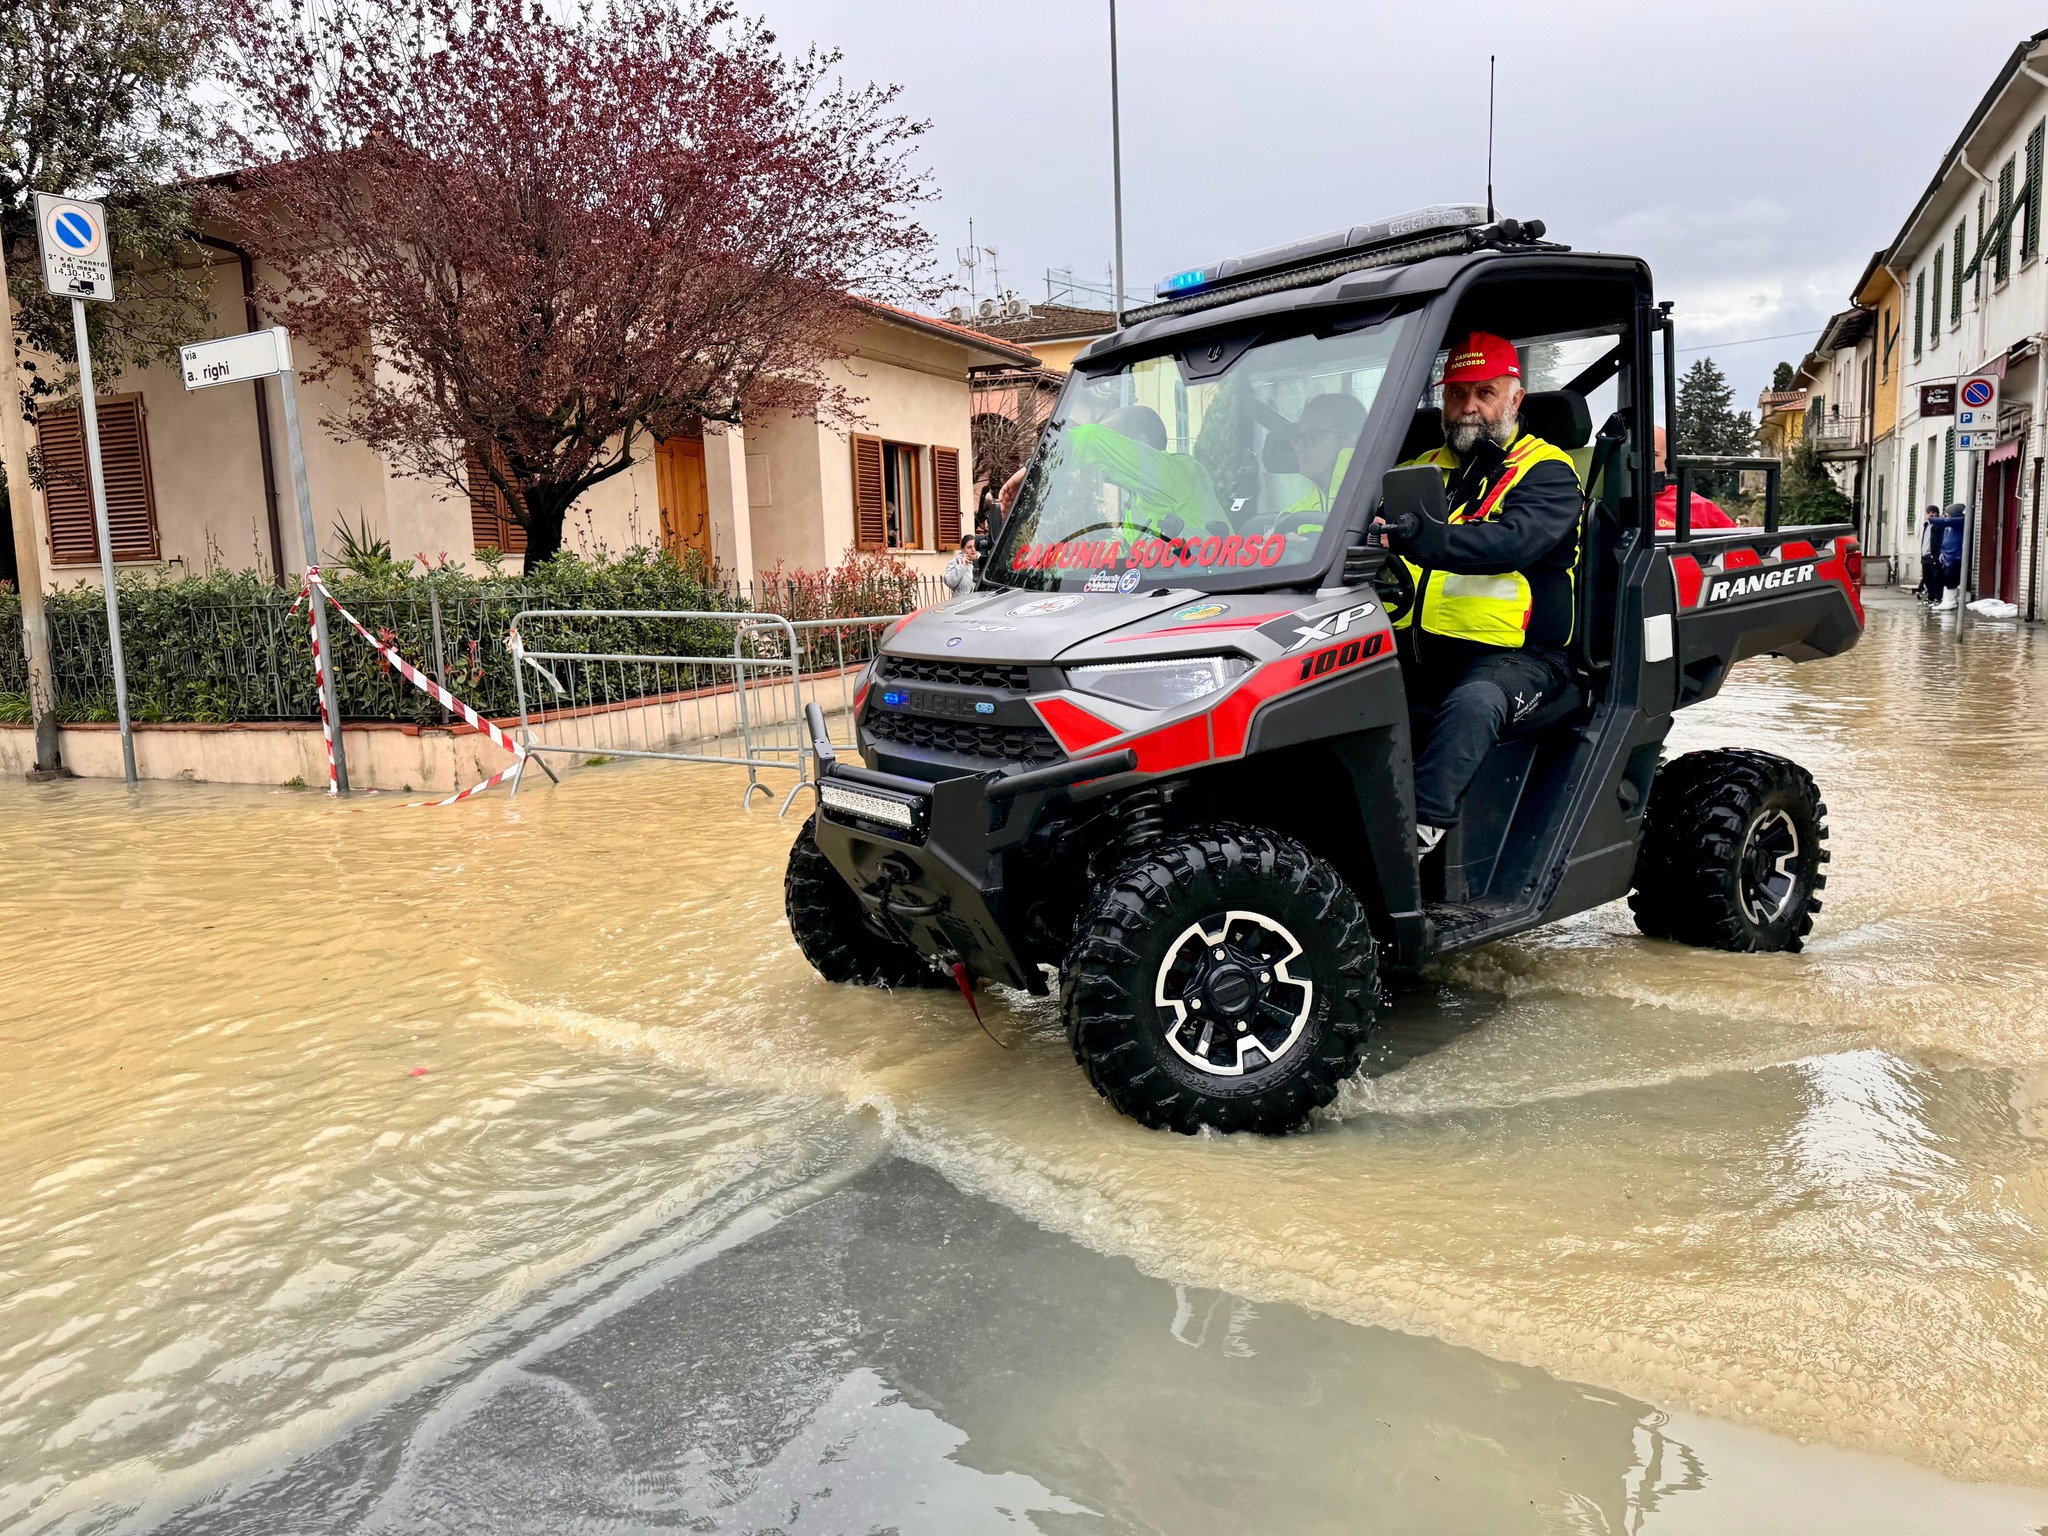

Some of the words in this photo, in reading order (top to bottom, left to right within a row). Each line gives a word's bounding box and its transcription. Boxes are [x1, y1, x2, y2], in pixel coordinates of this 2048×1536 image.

[184, 350, 197, 361] via
[1451, 359, 1486, 370] SOCCORSO
[1454, 352, 1484, 361] CAMUNIA
[187, 371, 198, 382] a.
[203, 360, 230, 381] righi
[1962, 413, 1971, 423] P
[1013, 540, 1121, 571] CAMUNIA
[1125, 533, 1286, 569] SOCCORSO
[1709, 563, 1815, 602] RANGER
[1280, 600, 1378, 656] XP
[1299, 633, 1384, 681] 1000
